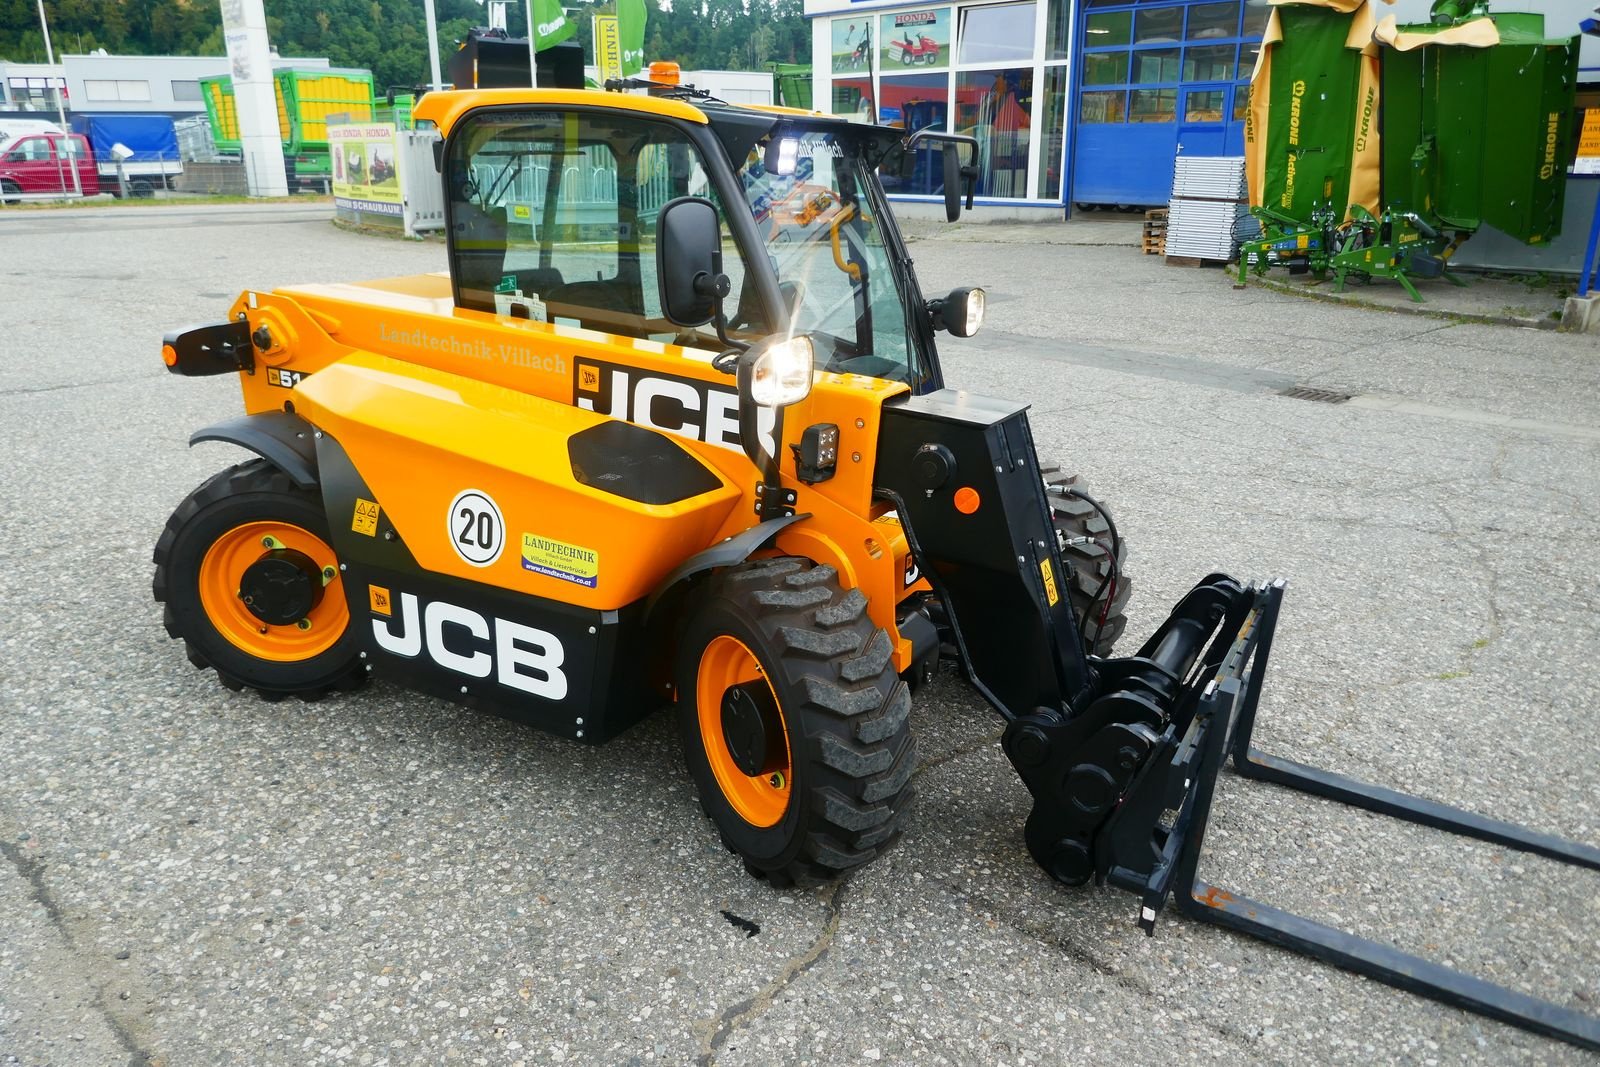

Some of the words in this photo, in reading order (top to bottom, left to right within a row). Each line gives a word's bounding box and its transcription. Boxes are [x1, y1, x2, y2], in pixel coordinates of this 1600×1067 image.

[895, 11, 936, 23] HONDA
[1246, 101, 1255, 143] KRONE
[1289, 97, 1301, 146] KRONE
[1361, 86, 1374, 137] KRONE
[366, 128, 391, 138] HONDA
[1545, 112, 1559, 163] KRONE
[379, 323, 567, 375] Landtechnik-Villach
[583, 370, 596, 385] JCB
[578, 370, 776, 459] JCB
[459, 508, 493, 550] 20
[524, 536, 595, 563] LANDTECHNIK
[525, 563, 592, 587] www.landtechnik.co.at
[530, 555, 548, 565] Villach
[374, 592, 388, 607] JCB
[372, 592, 568, 700] JCB
